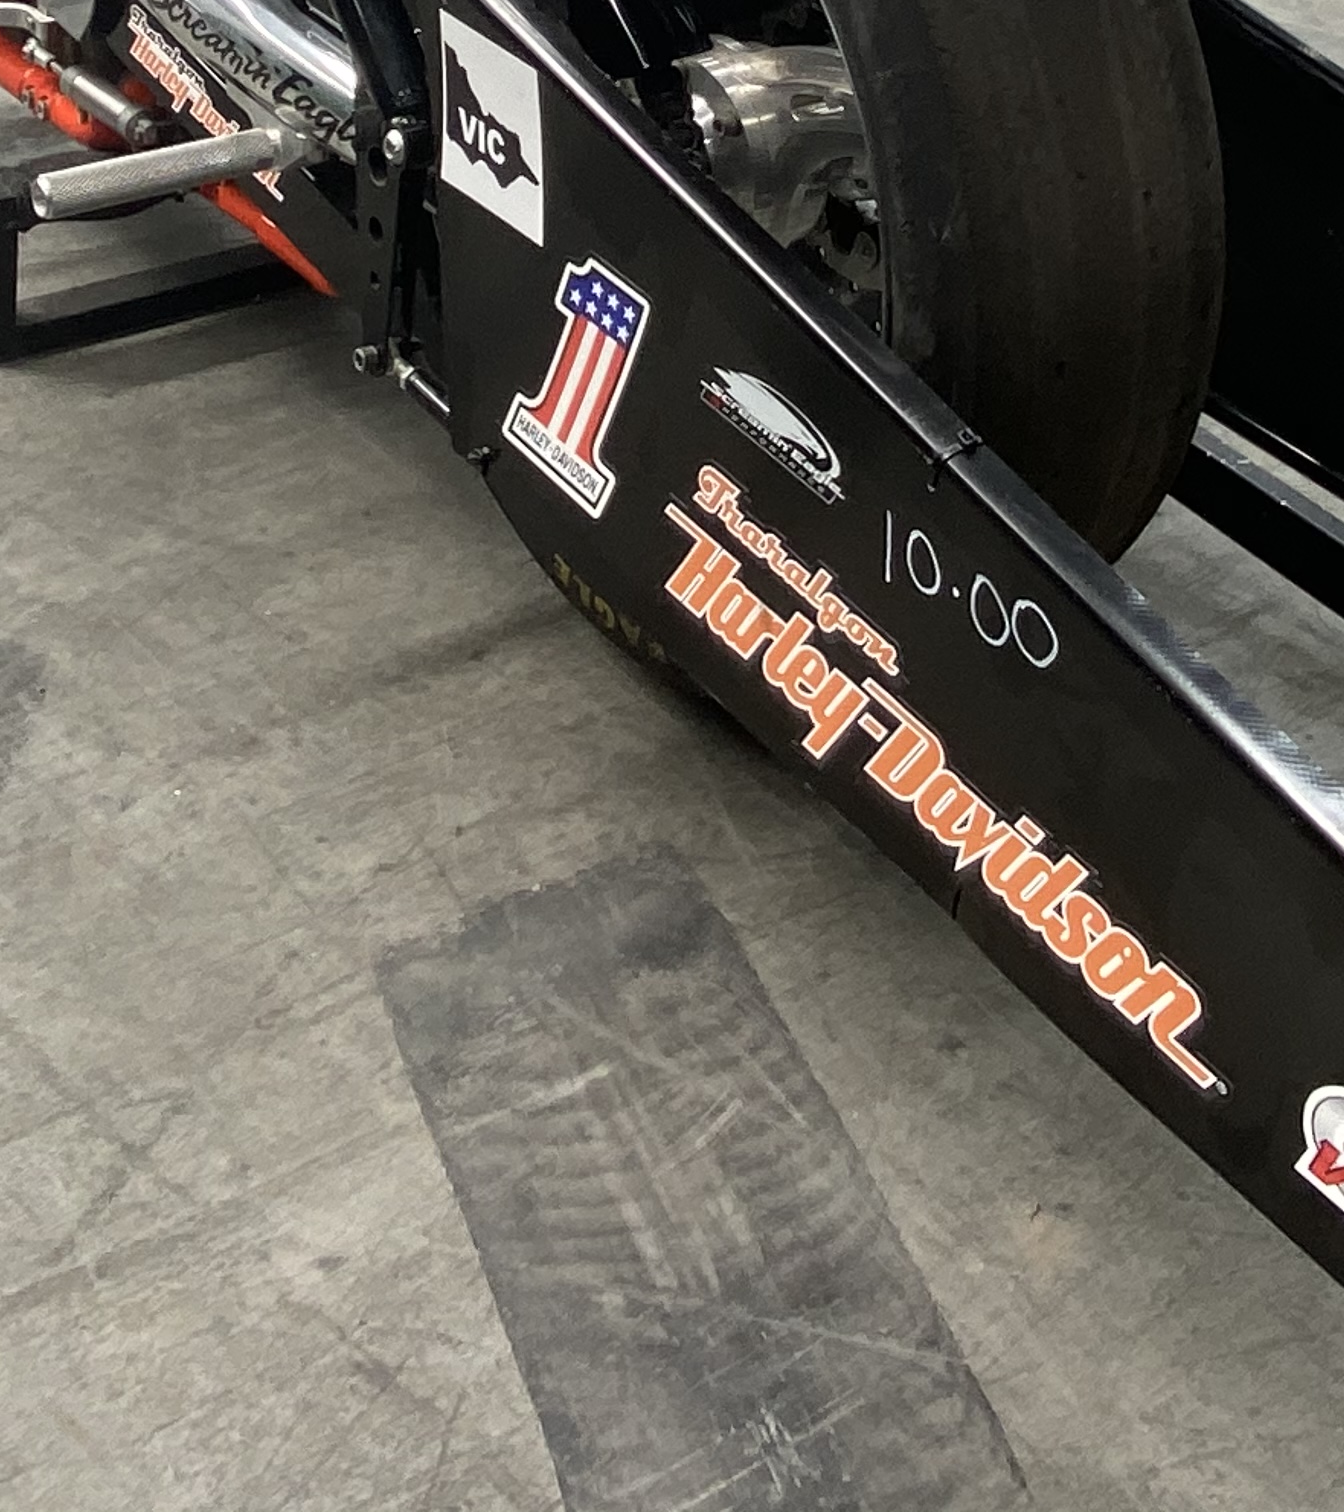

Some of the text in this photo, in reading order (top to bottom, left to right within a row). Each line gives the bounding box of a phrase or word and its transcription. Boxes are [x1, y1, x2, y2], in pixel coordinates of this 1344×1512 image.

[457, 106, 506, 166] VIC
[517, 414, 599, 494] HARLEY-DAVIDSON
[695, 464, 901, 676] Traralgon
[884, 509, 1059, 668] 10.00
[664, 502, 1218, 1090] Harley-Davidson
